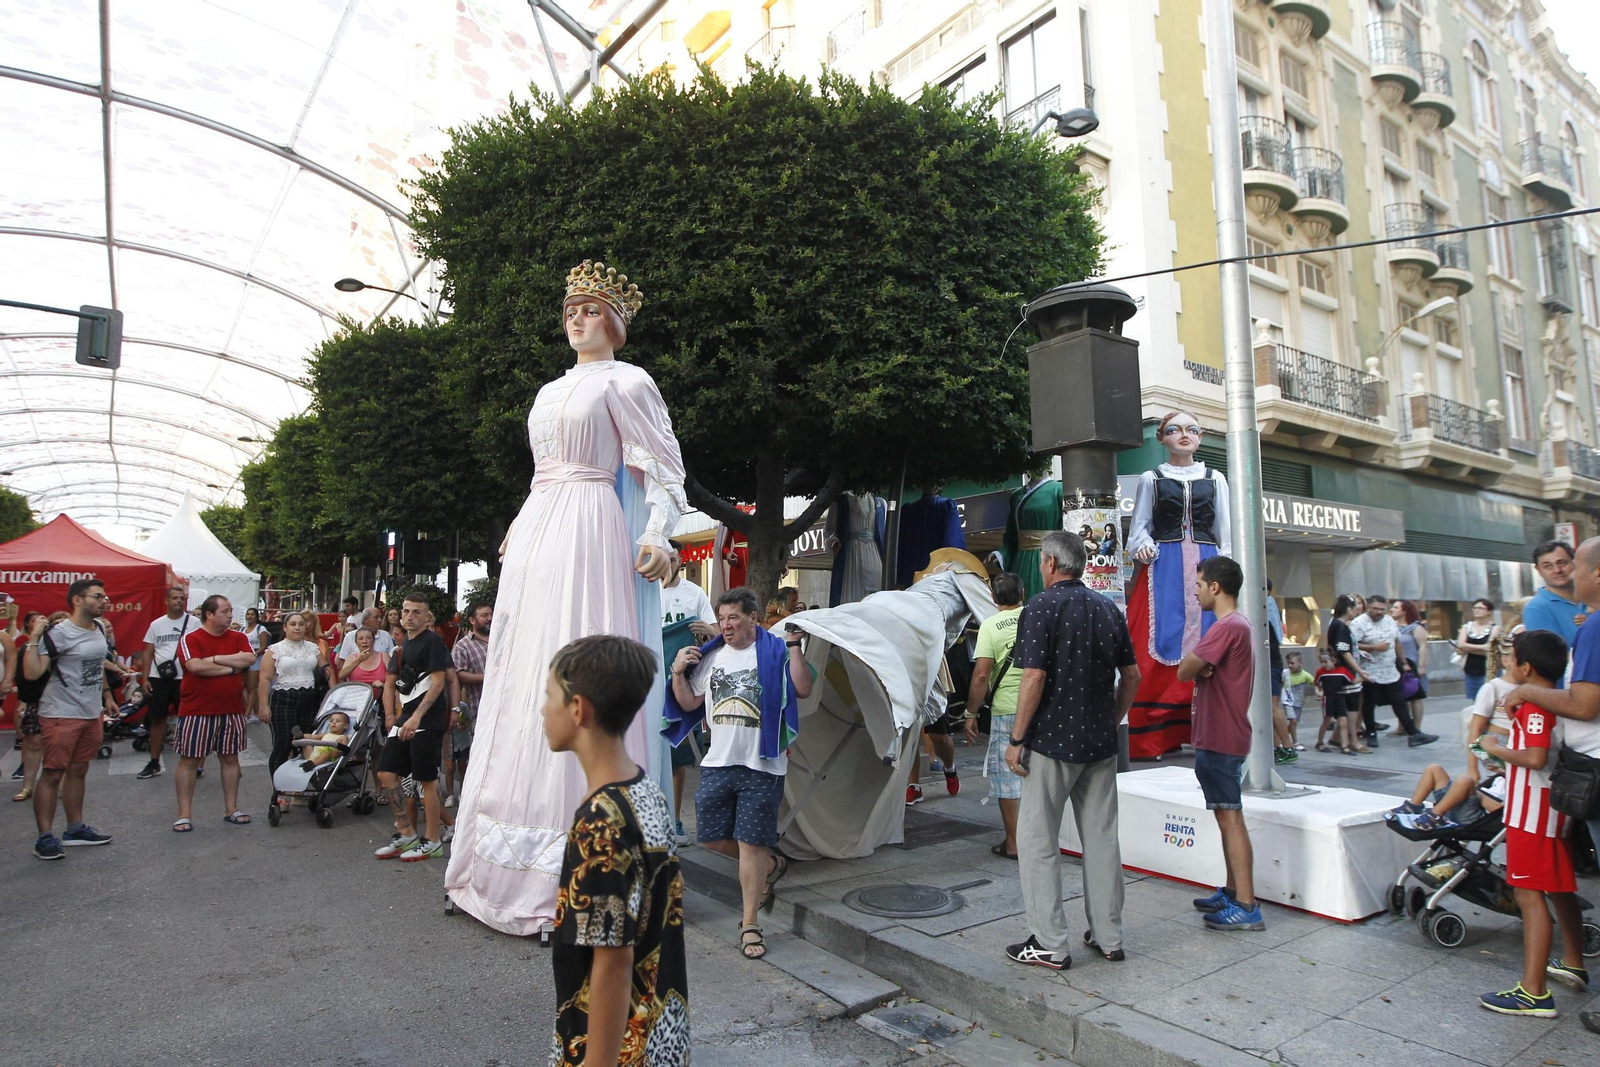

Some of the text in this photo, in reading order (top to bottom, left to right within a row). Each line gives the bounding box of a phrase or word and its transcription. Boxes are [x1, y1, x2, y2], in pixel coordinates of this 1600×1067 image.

[1292, 502, 1362, 532] REGENTE
[0, 569, 94, 585] ruzcampo
[1166, 814, 1195, 823] GRUPO
[1165, 823, 1195, 836] RENTA
[1164, 834, 1194, 848] TODO
